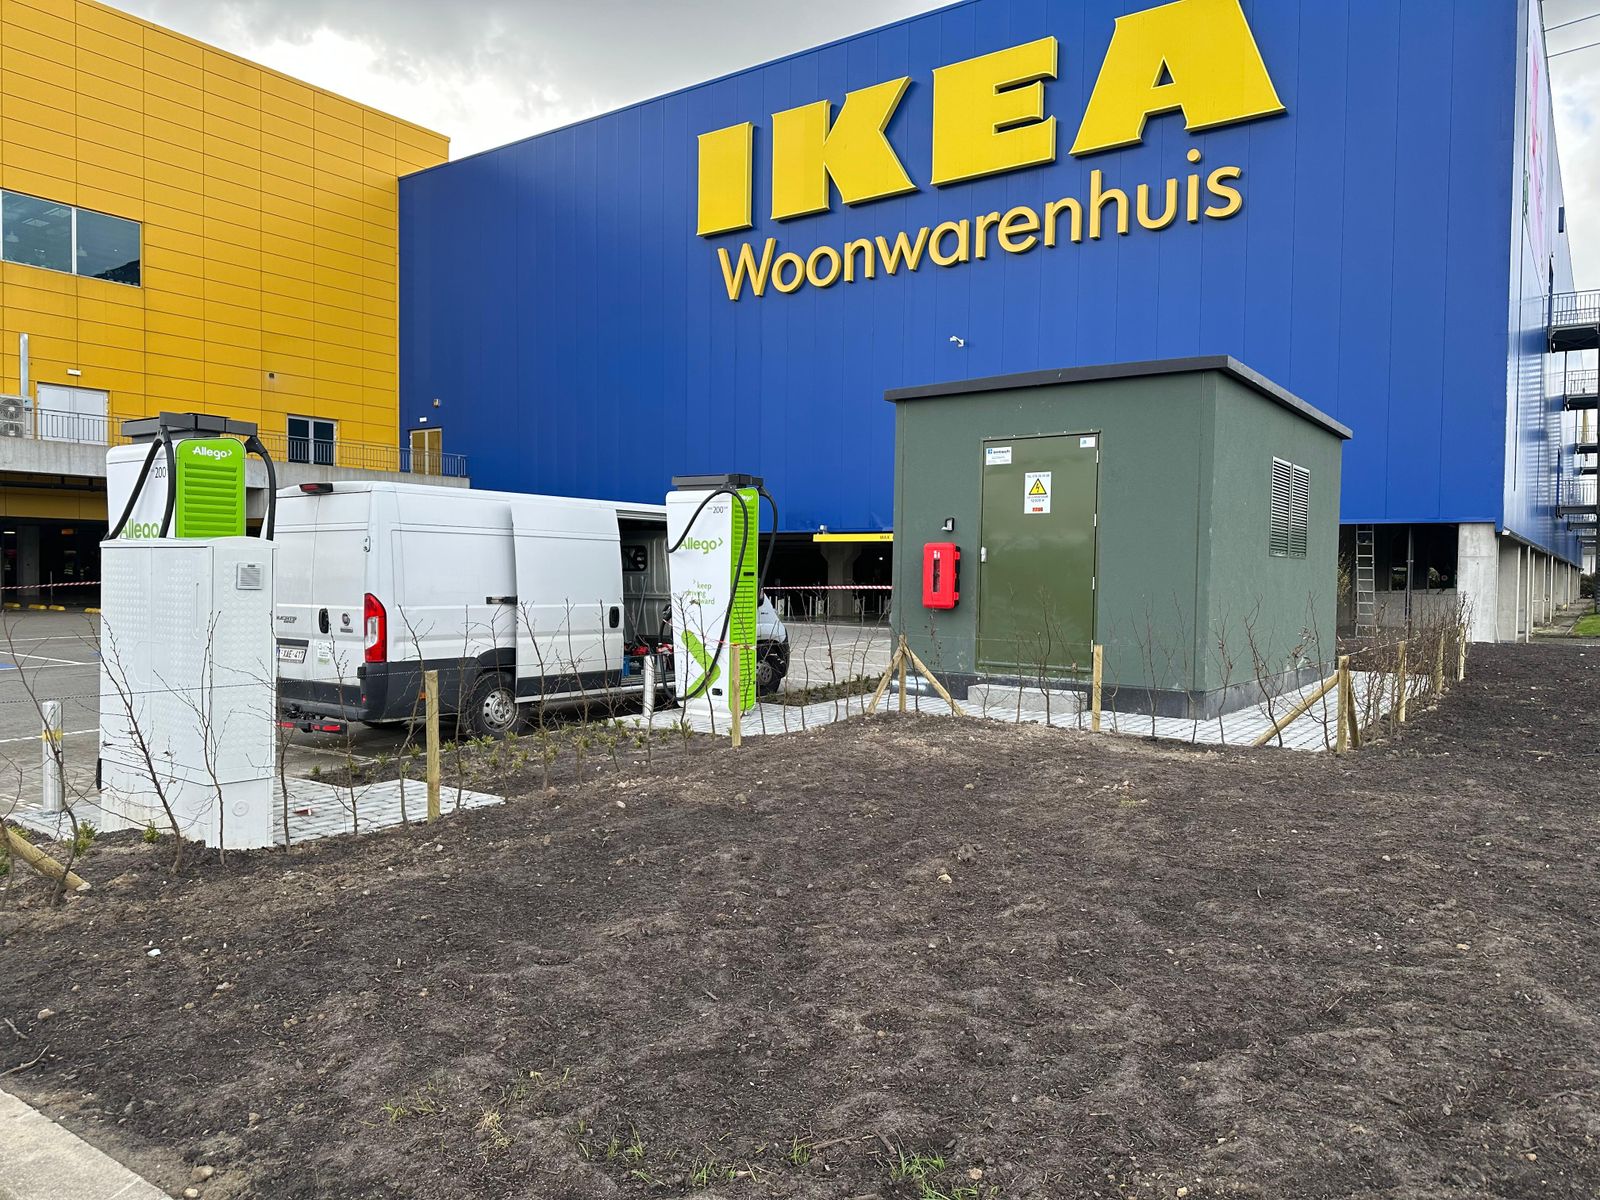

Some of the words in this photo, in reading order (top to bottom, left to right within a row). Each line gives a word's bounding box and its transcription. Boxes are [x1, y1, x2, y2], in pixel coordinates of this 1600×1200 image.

[697, 0, 1287, 238] IKEA
[718, 148, 1244, 301] Woonwarenhuis
[154, 466, 167, 479] 200
[712, 506, 724, 514] 200
[697, 581, 712, 591] keep
